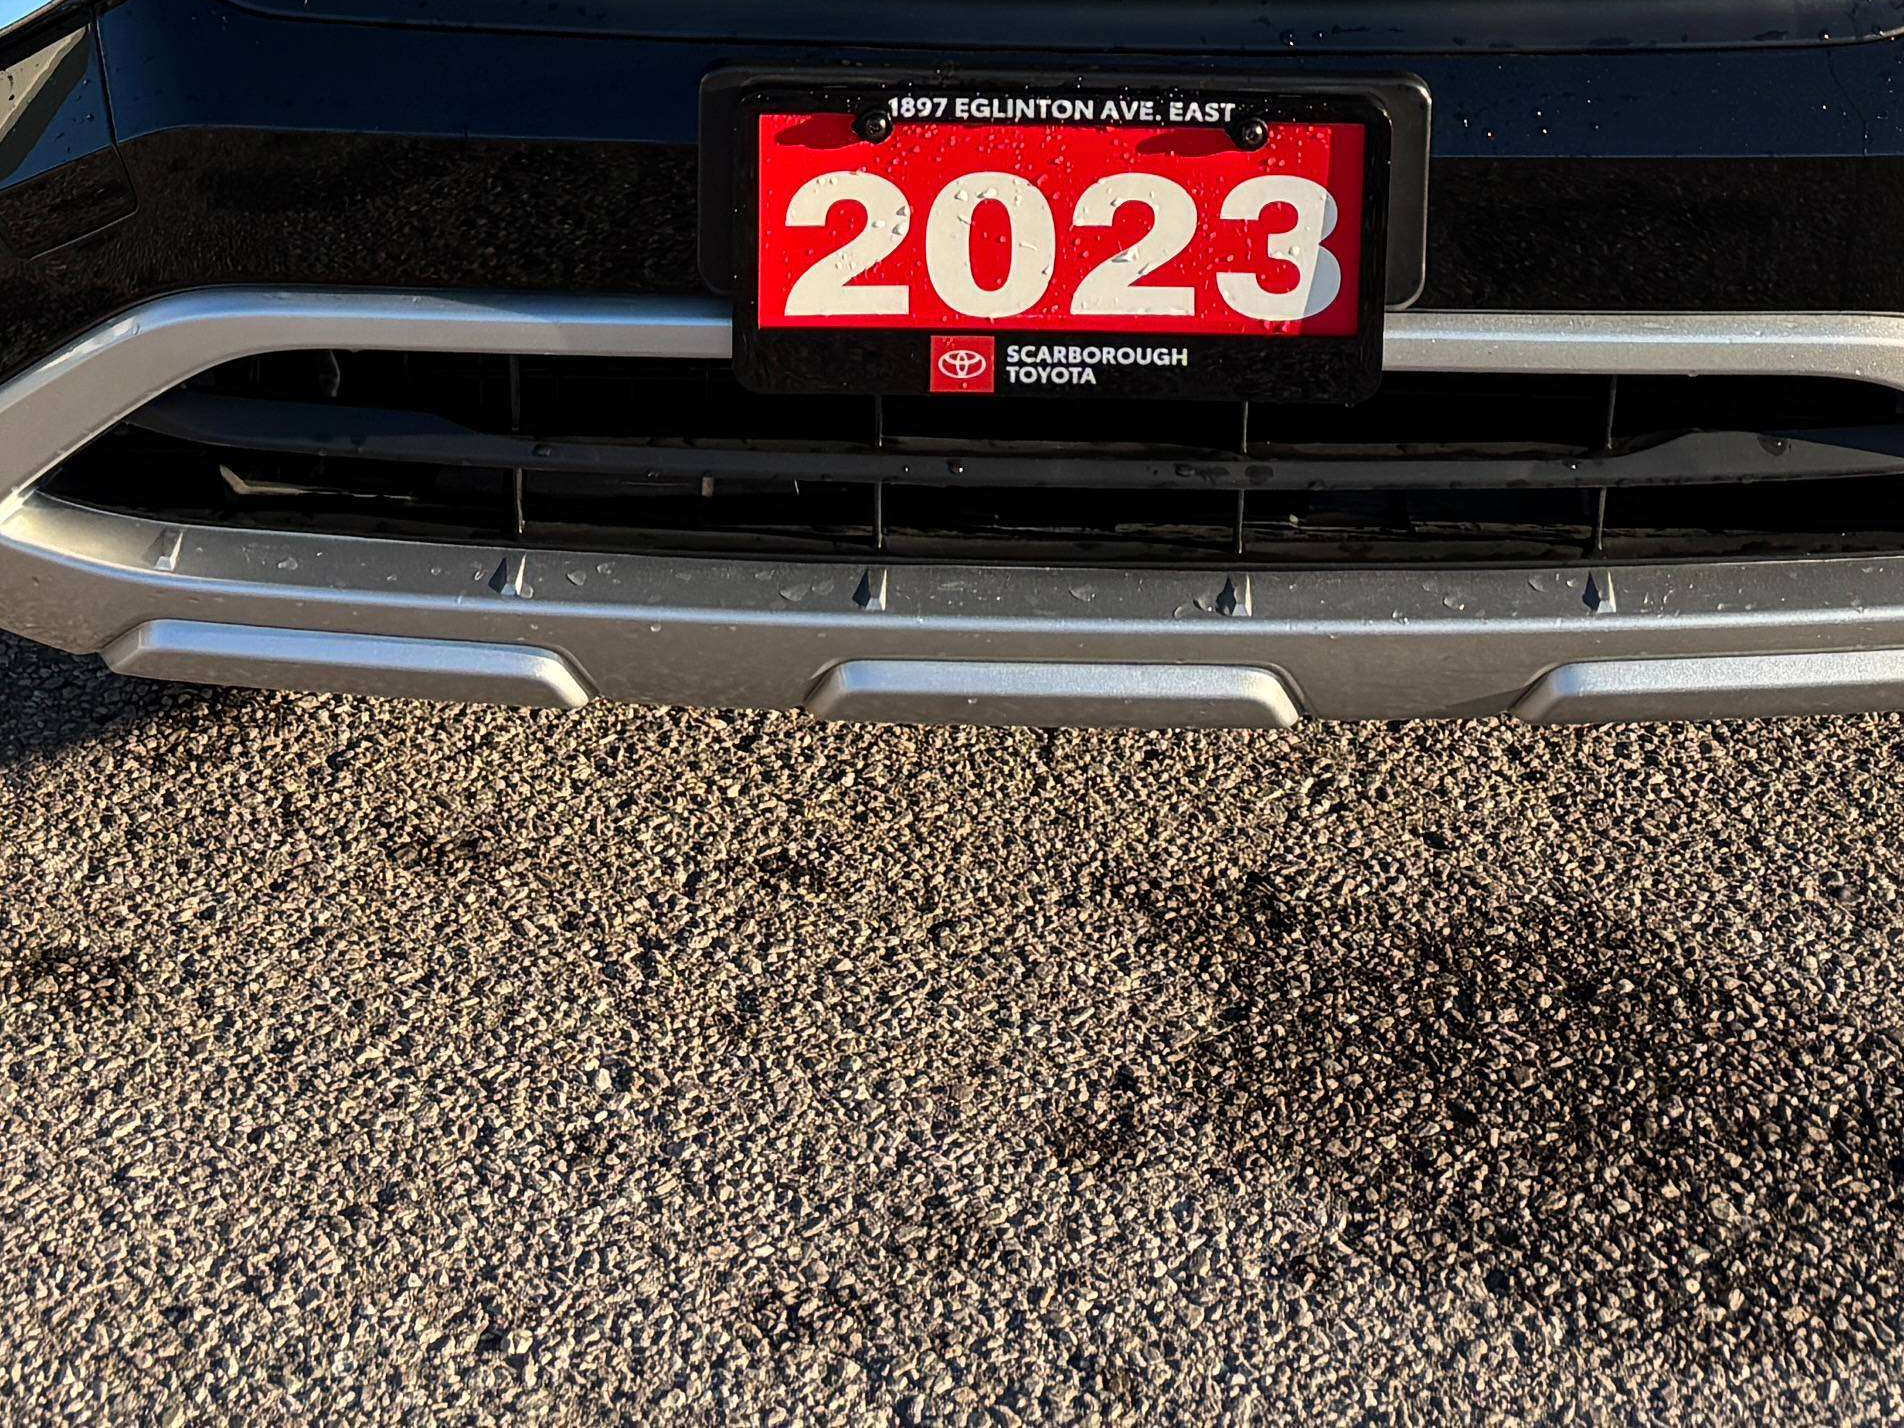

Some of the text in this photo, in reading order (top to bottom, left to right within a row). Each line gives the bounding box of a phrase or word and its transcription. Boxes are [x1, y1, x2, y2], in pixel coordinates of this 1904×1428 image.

[889, 97, 1236, 123] 1897 EGLINTON AVE. EAST
[783, 171, 1342, 321] 2023
[1005, 345, 1189, 367] SCARBOROUGH
[1005, 365, 1097, 386] TOYOTA
